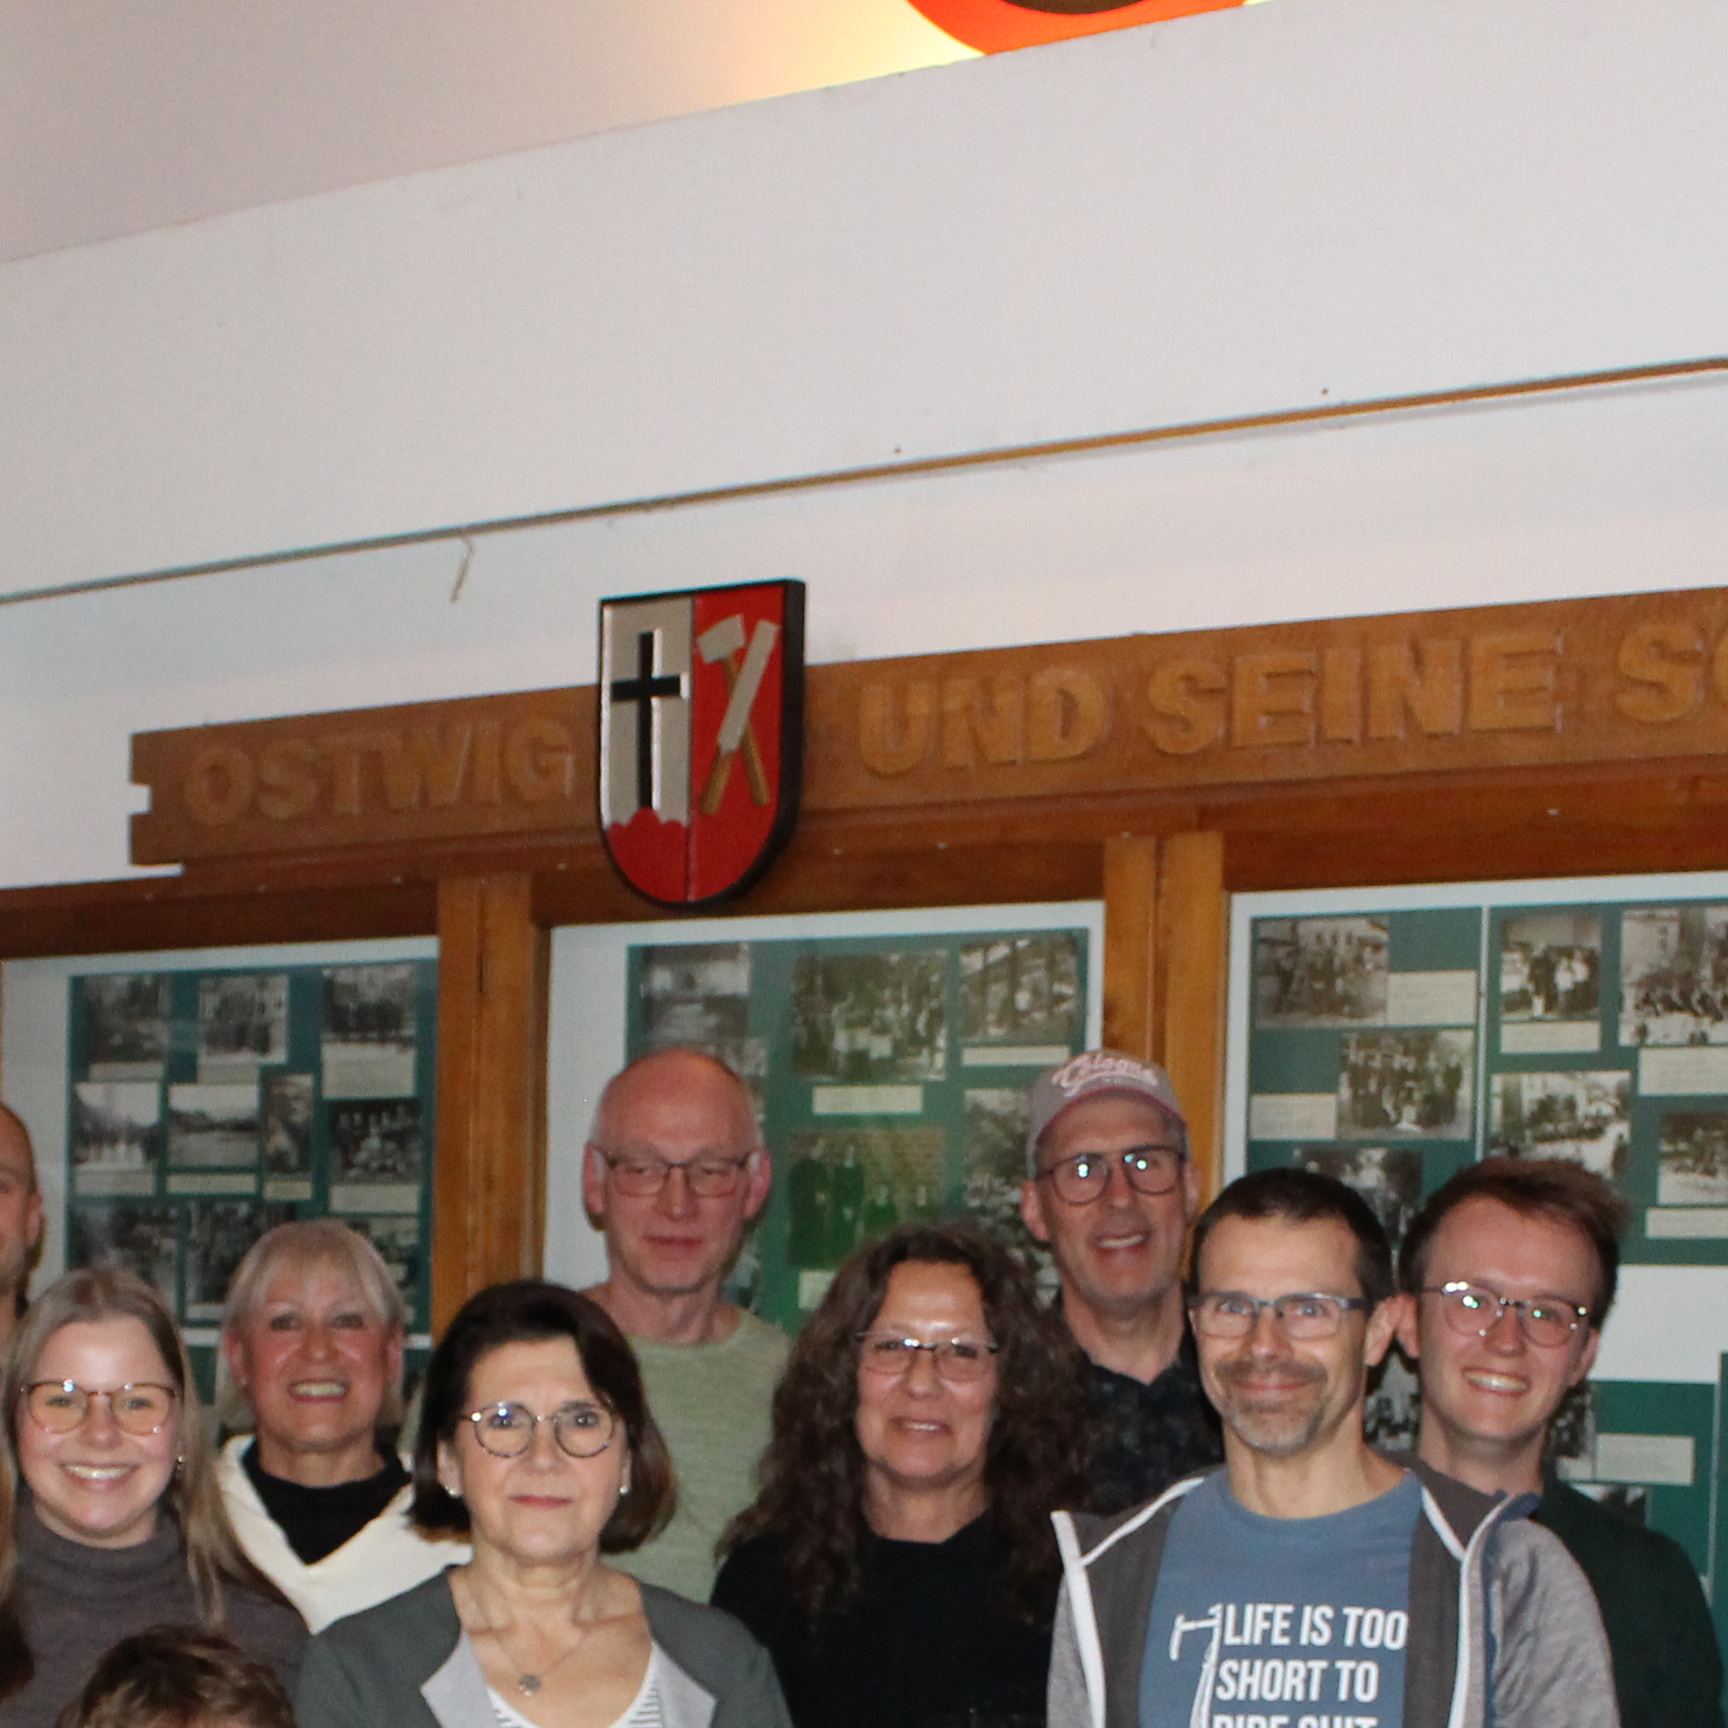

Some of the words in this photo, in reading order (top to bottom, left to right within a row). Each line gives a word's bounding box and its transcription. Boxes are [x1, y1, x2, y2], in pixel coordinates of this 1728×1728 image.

[184, 710, 574, 826] OSTWIG
[858, 668, 1110, 778] UND
[1144, 632, 1563, 755] SEINE
[1223, 1602, 1294, 1646] LIFE
[1298, 1604, 1335, 1646] IS
[1342, 1605, 1409, 1651] TOO
[1215, 1658, 1329, 1702] SHORT
[1334, 1660, 1380, 1703] TO
